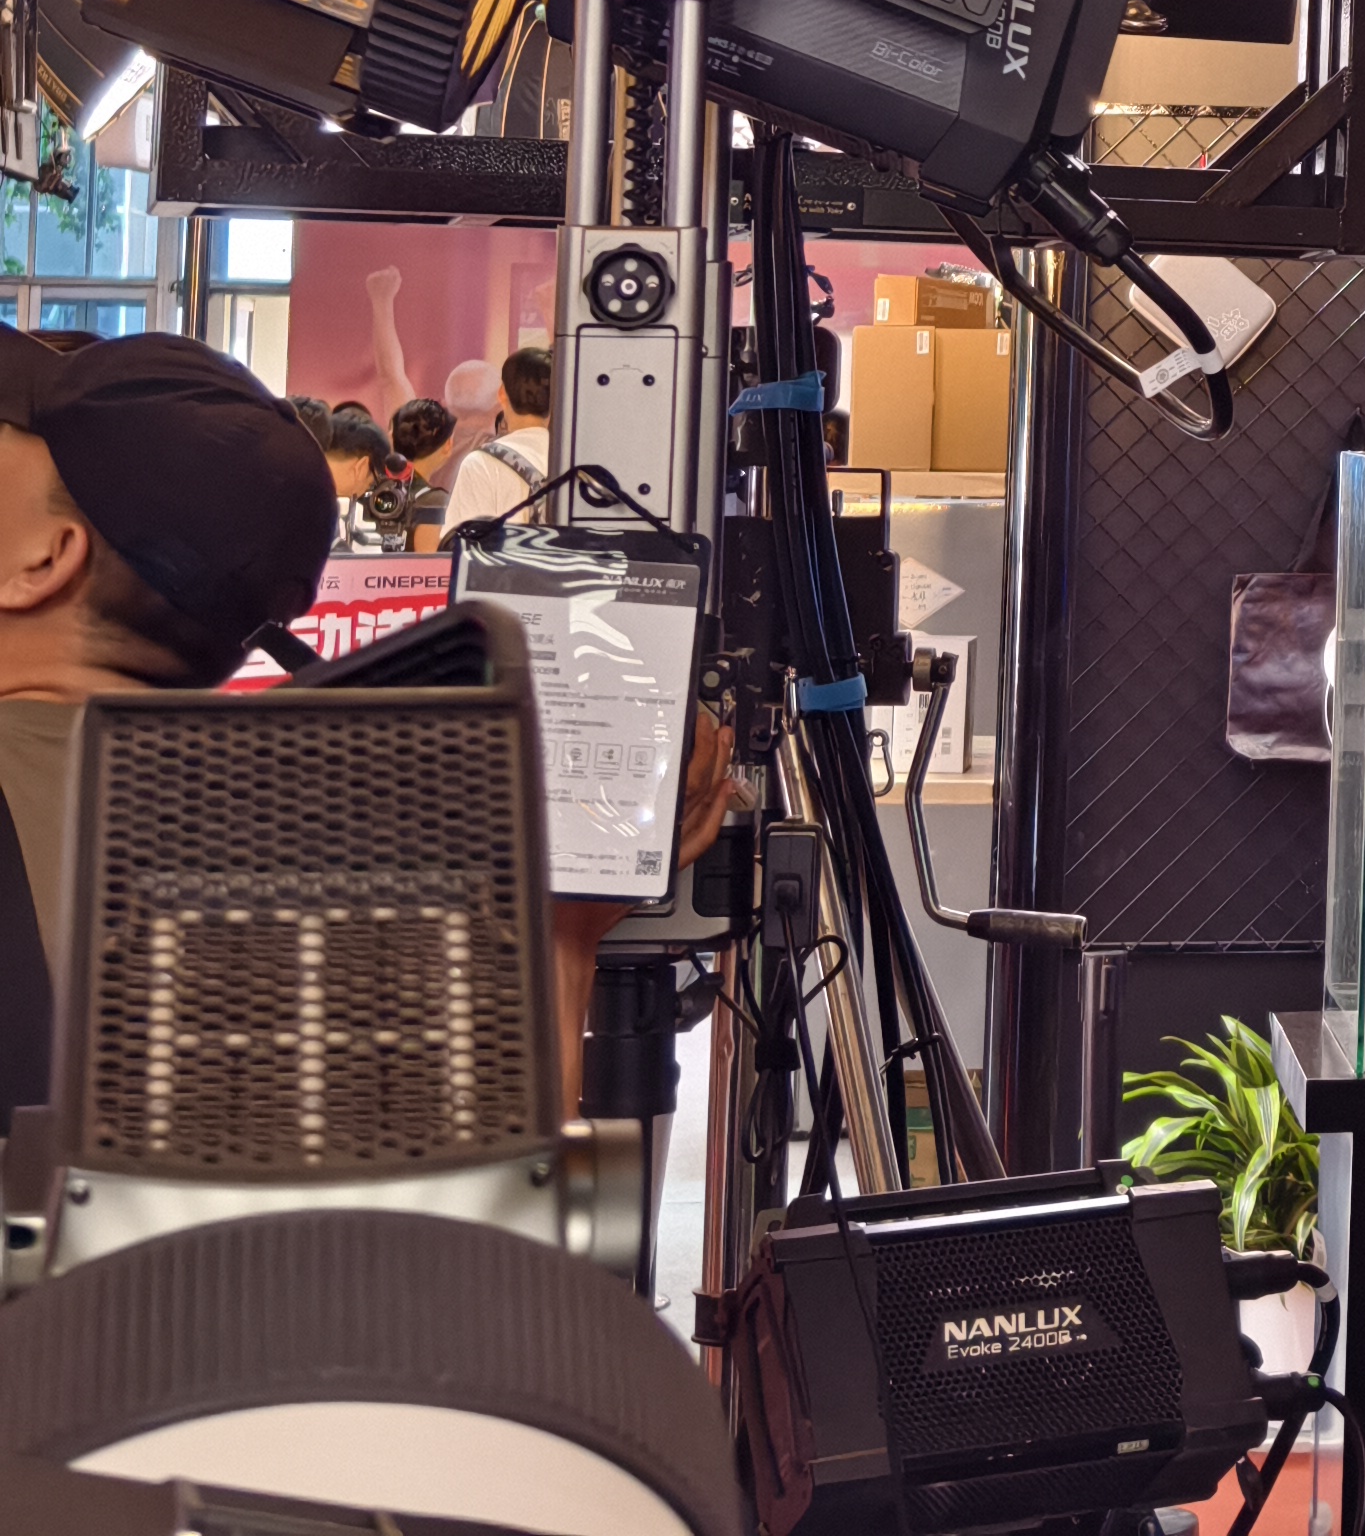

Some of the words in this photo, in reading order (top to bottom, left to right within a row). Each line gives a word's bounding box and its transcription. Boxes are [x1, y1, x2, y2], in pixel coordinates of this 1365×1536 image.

[871, 40, 943, 77] Bi-Color
[364, 575, 450, 589] CINEPEE
[944, 1304, 1083, 1343] NANLUX
[947, 1341, 1002, 1360] Evoke
